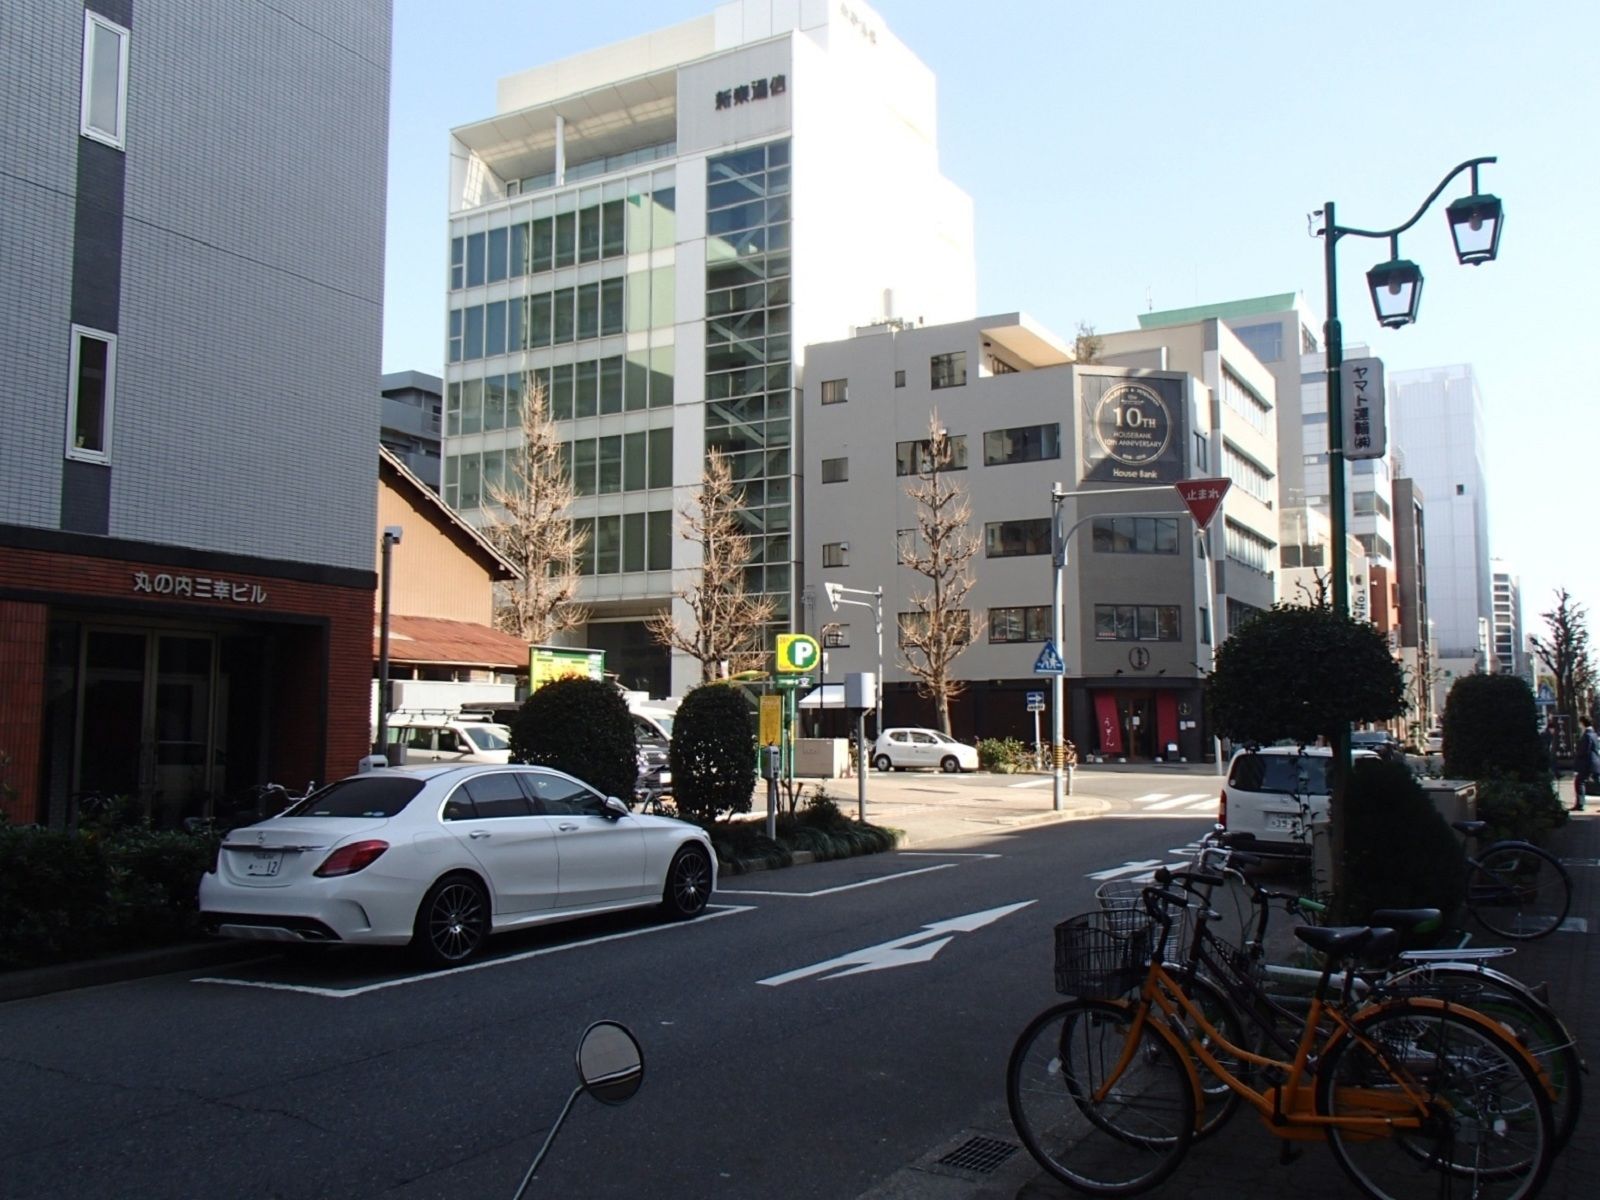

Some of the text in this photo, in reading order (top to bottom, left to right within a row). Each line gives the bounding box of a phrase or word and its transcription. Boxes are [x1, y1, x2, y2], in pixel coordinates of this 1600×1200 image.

[1112, 468, 1158, 479] House Bank
[1185, 488, 1220, 500] 止まれ
[133, 571, 267, 603] 丸の内三幸ビル
[795, 641, 814, 666] P
